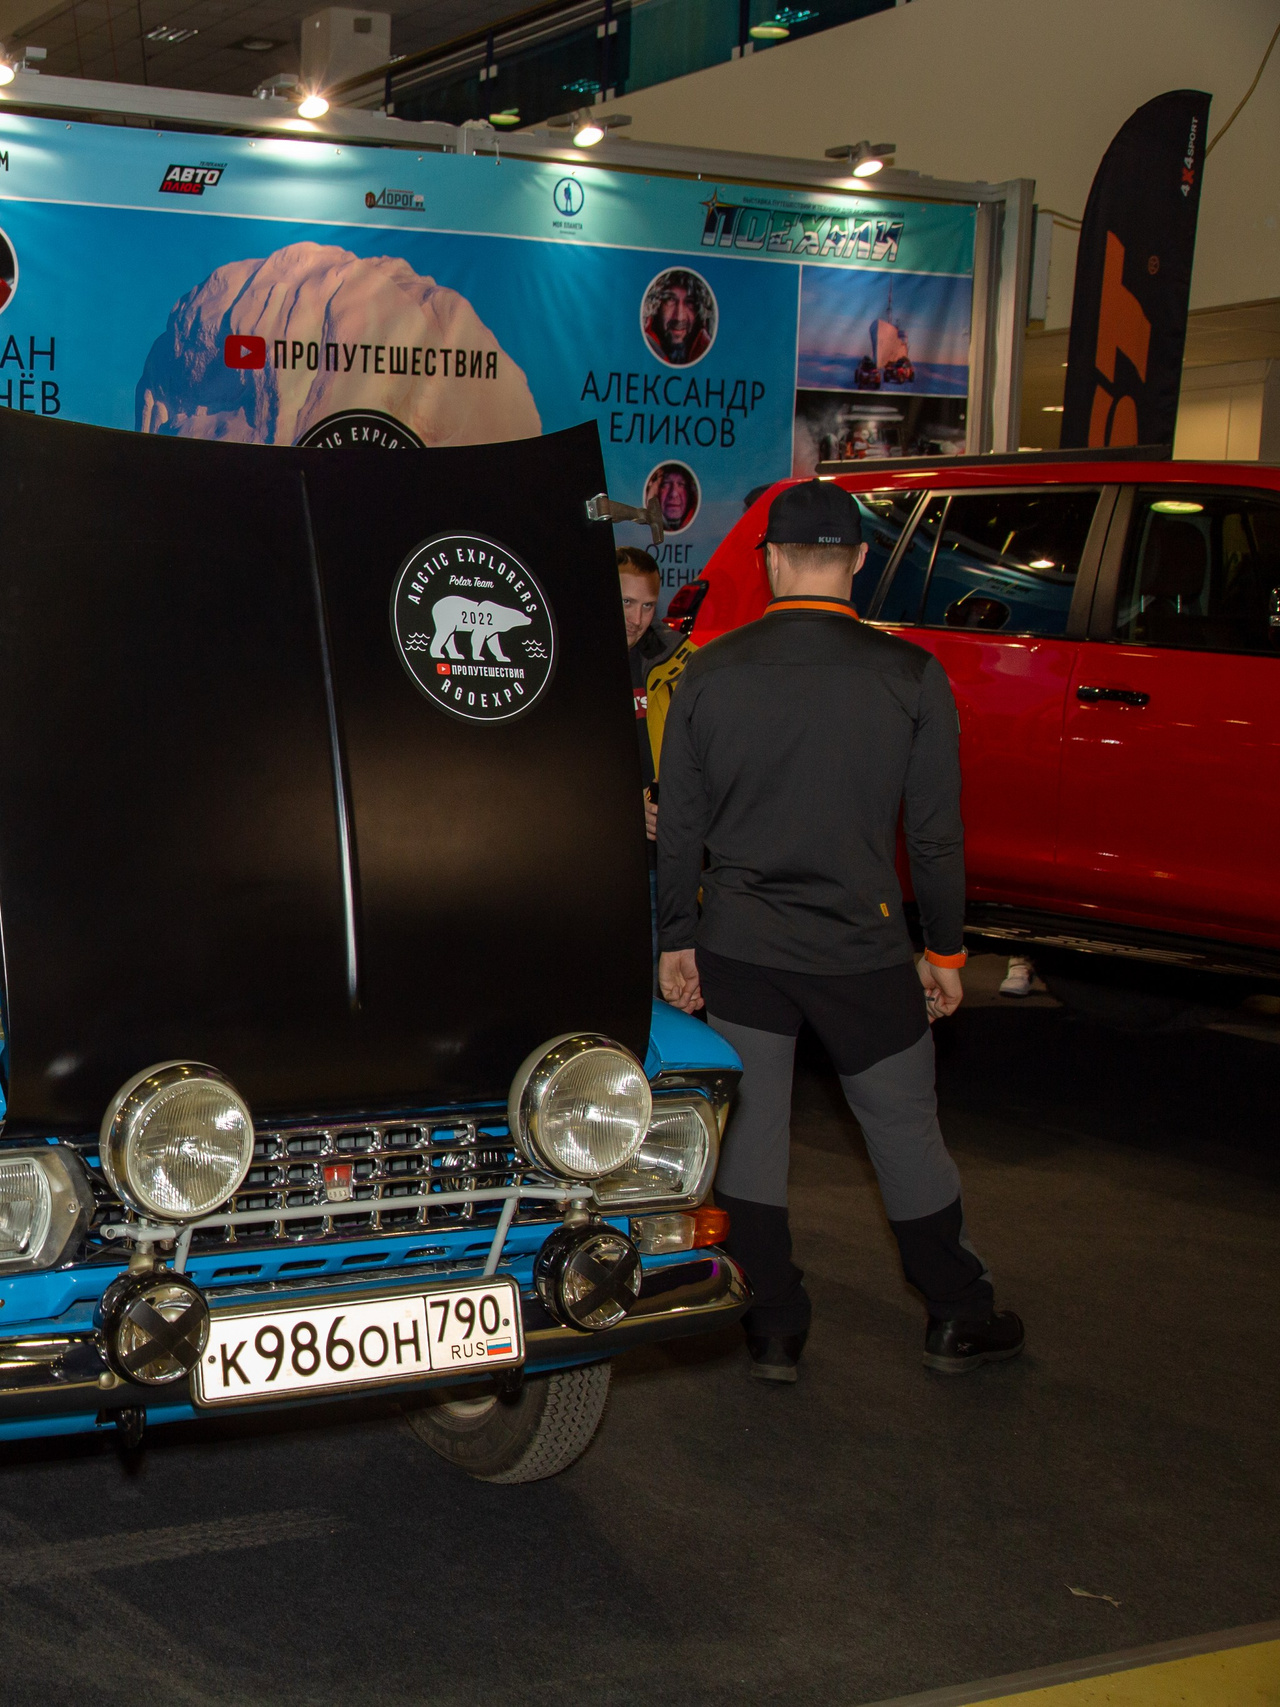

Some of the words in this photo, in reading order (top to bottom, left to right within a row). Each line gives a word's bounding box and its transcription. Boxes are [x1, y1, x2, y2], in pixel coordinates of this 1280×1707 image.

[166, 166, 220, 185] АВТО
[162, 181, 201, 193] ПЛЮС
[580, 370, 766, 418] АЛЕКСАНДР
[351, 427, 407, 449] EXPLO
[610, 411, 736, 448] ЕЛИКОВ
[646, 543, 693, 564] ОЛЕГ
[408, 552, 449, 605] ARCTIC
[456, 548, 537, 613] EXPLORERS
[449, 575, 472, 587] Polar
[473, 576, 494, 589] Team
[461, 610, 493, 626] 2022
[440, 678, 524, 708] RGOEXPO
[429, 1293, 500, 1344] 790
[451, 1340, 486, 1361] RUS
